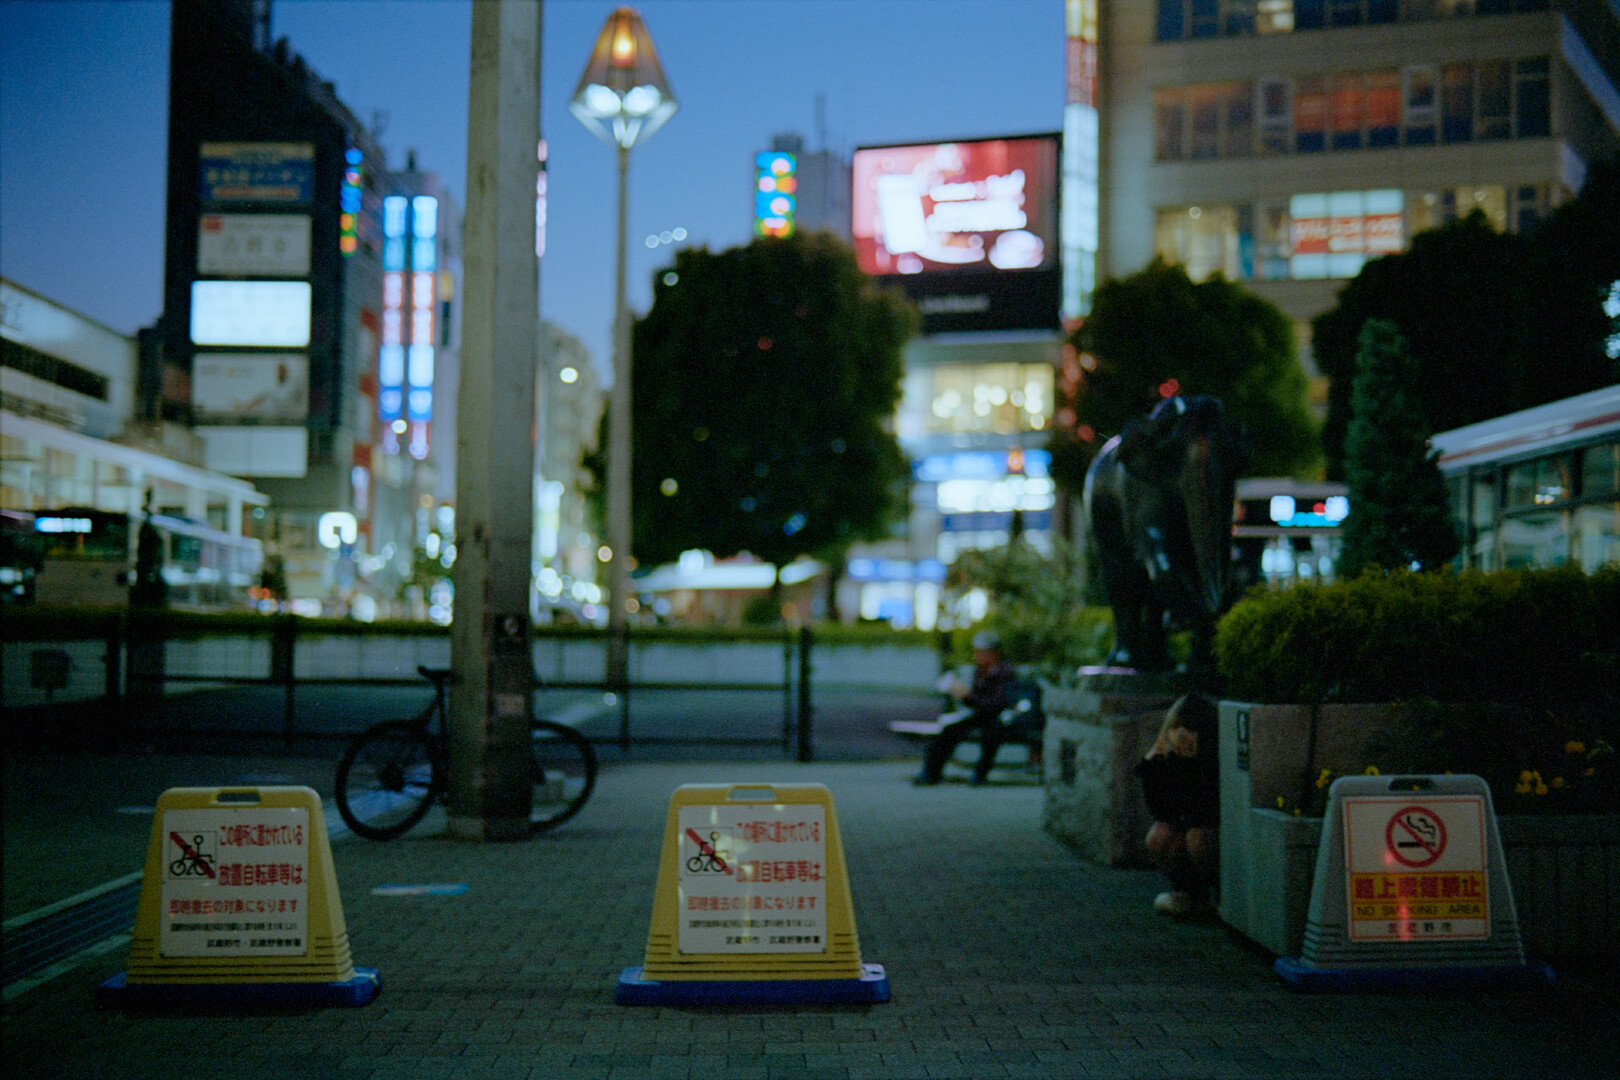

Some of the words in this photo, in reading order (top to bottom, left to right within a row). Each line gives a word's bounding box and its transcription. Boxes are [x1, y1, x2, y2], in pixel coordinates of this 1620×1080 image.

[218, 864, 303, 886] 放置自転車等は
[1355, 877, 1482, 899] 路上喫煙禁止
[1357, 906, 1376, 916] NO
[1382, 905, 1438, 916] SMKING
[1449, 904, 1481, 914] AREA
